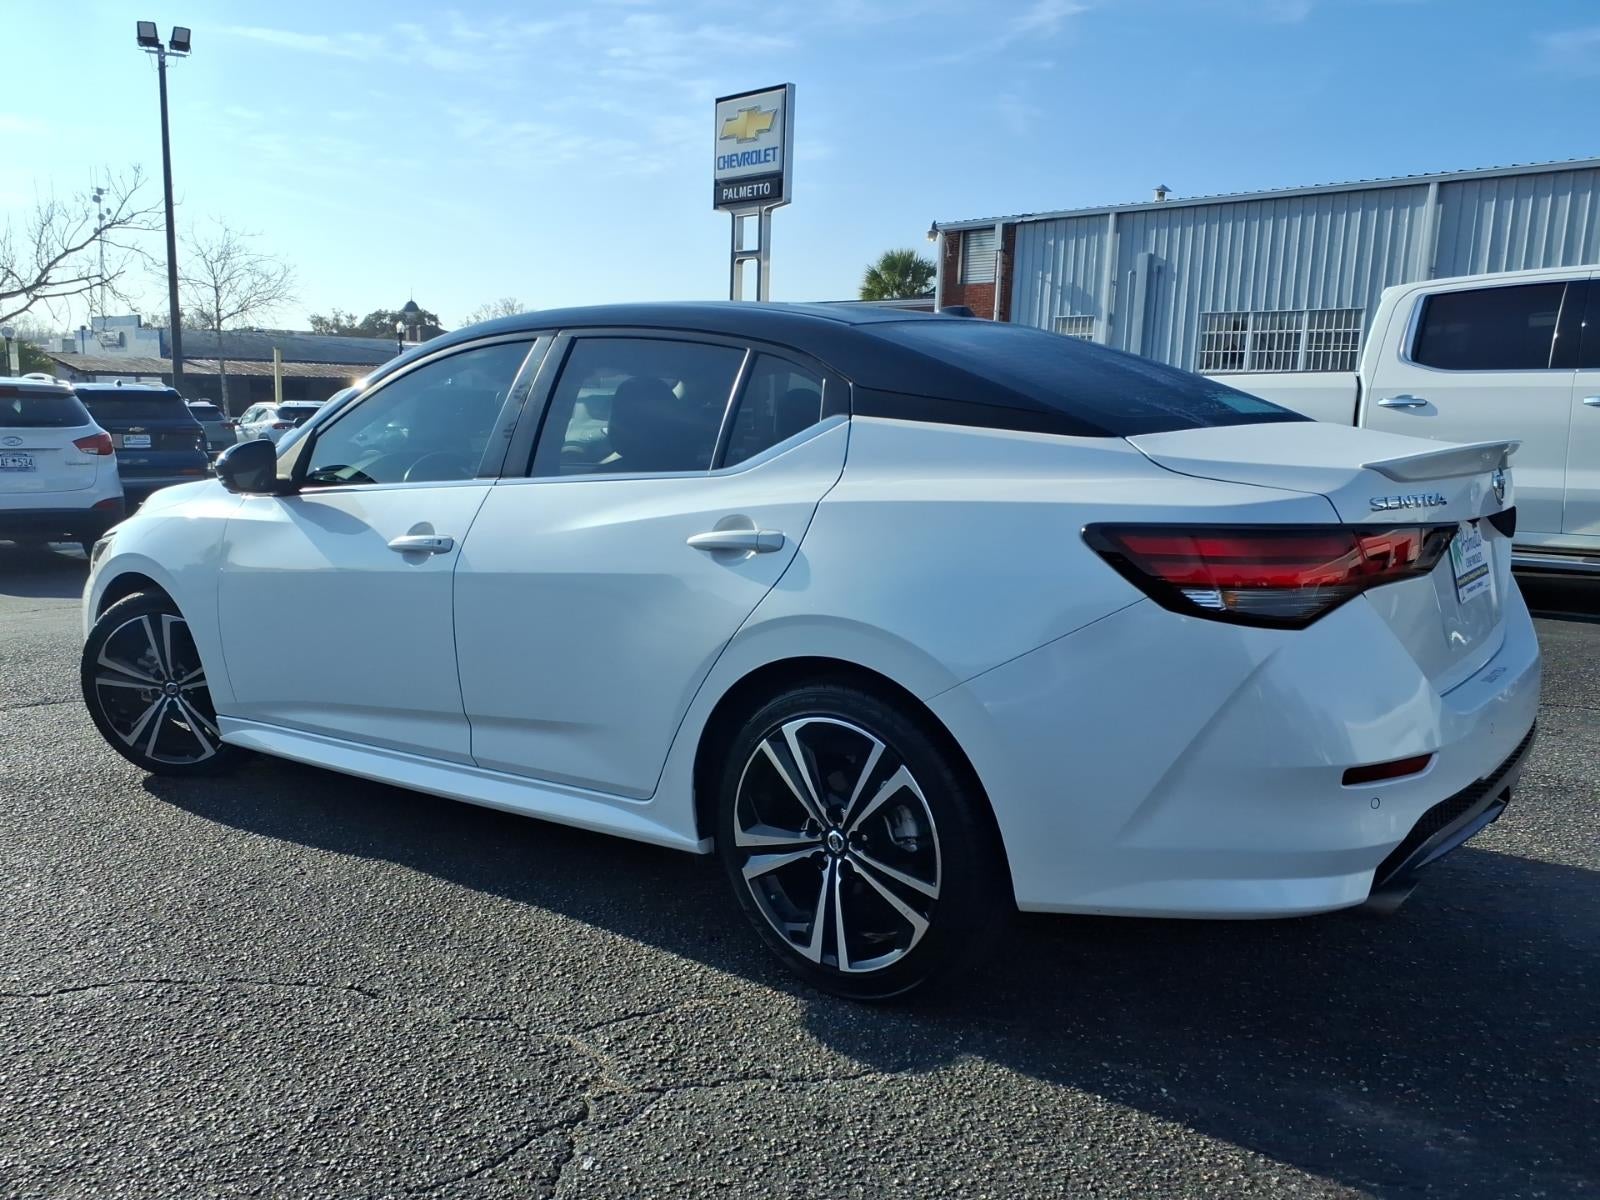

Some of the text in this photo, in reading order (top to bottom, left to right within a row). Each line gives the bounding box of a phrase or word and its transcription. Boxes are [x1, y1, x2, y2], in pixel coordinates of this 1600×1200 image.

[717, 146, 779, 171] CHEVROLET
[722, 182, 771, 200] PALMETTO
[1369, 493, 1447, 512] SENTRA
